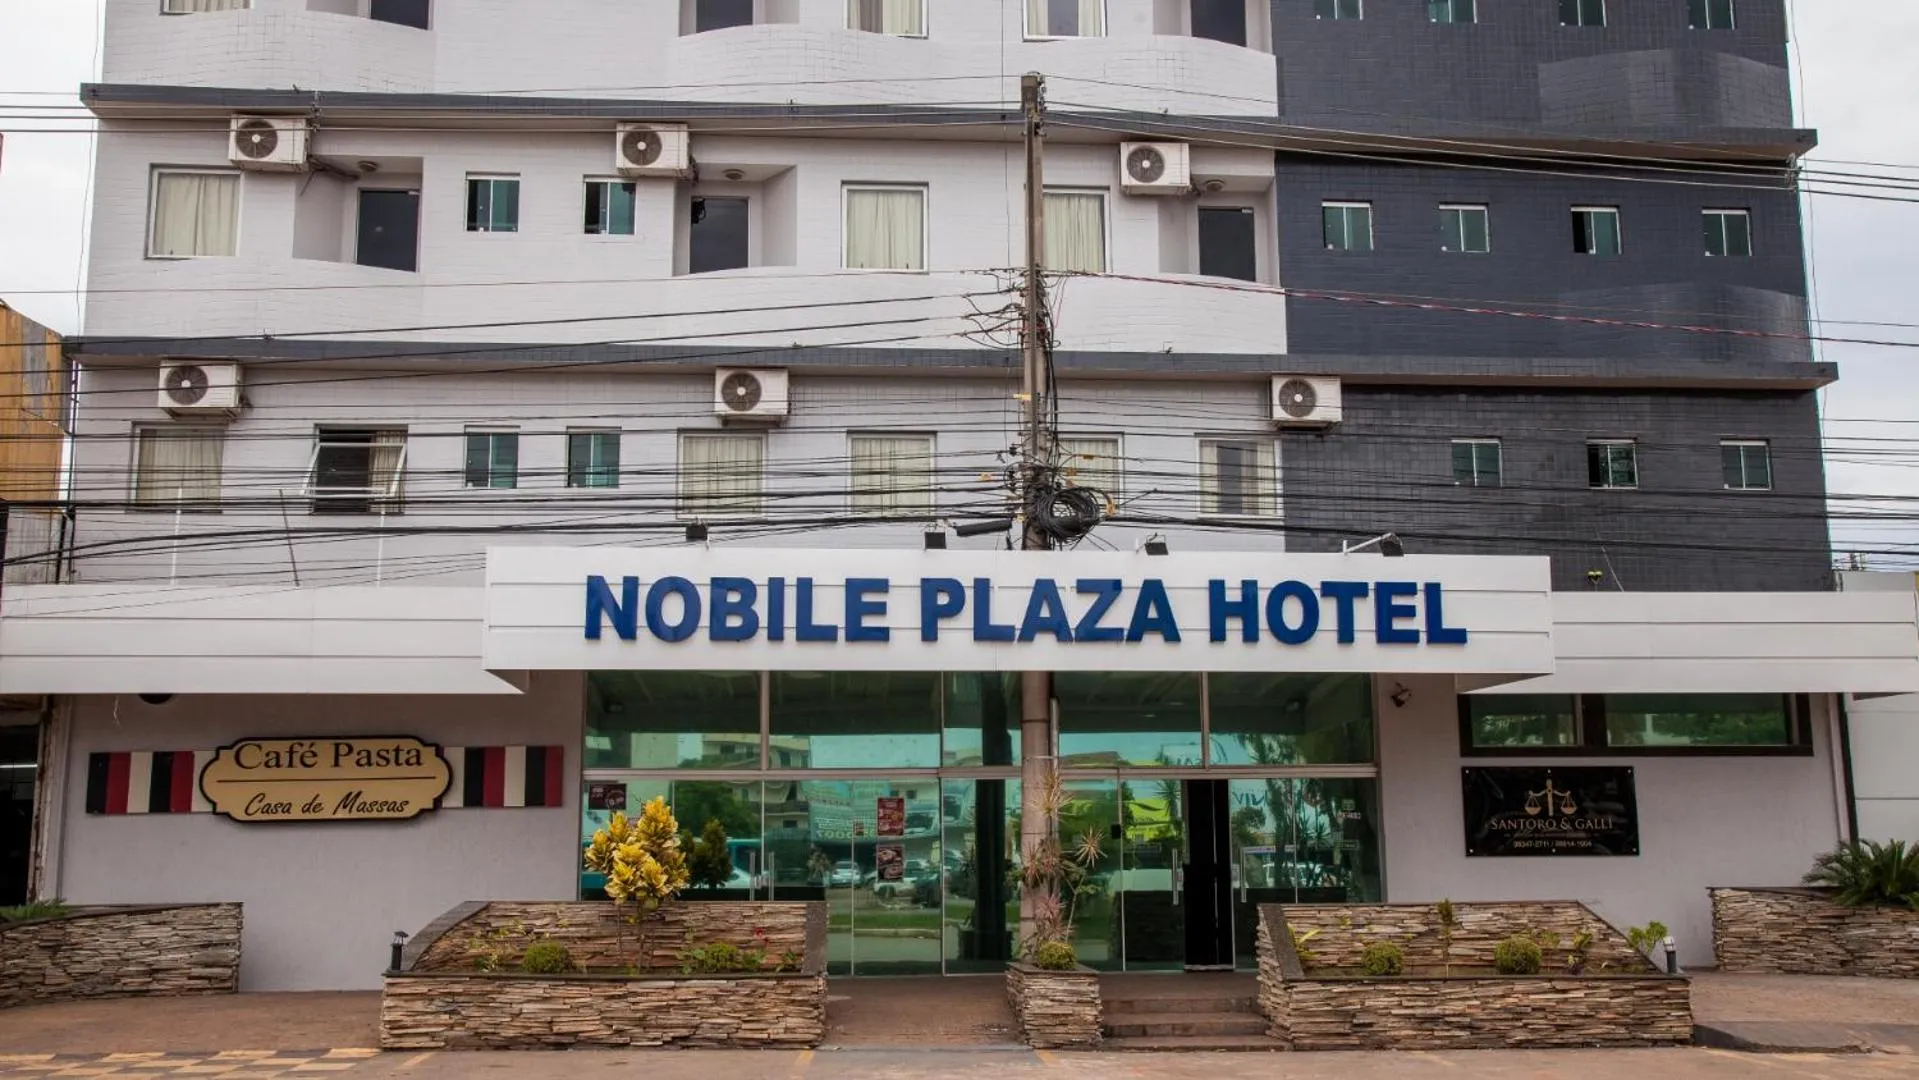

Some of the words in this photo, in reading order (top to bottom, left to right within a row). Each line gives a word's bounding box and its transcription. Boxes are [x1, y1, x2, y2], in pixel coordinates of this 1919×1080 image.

[584, 575, 890, 643] NOBILE
[919, 577, 1182, 644] PLAZA
[1208, 578, 1468, 645] HOTEL
[233, 742, 319, 770] Café
[330, 741, 425, 769] Pasta
[244, 792, 292, 816] Casa
[301, 793, 324, 815] de
[332, 789, 410, 816] Massas
[1491, 818, 1557, 831] SANTORO
[1560, 816, 1573, 830] &
[1574, 817, 1613, 830] GALLI
